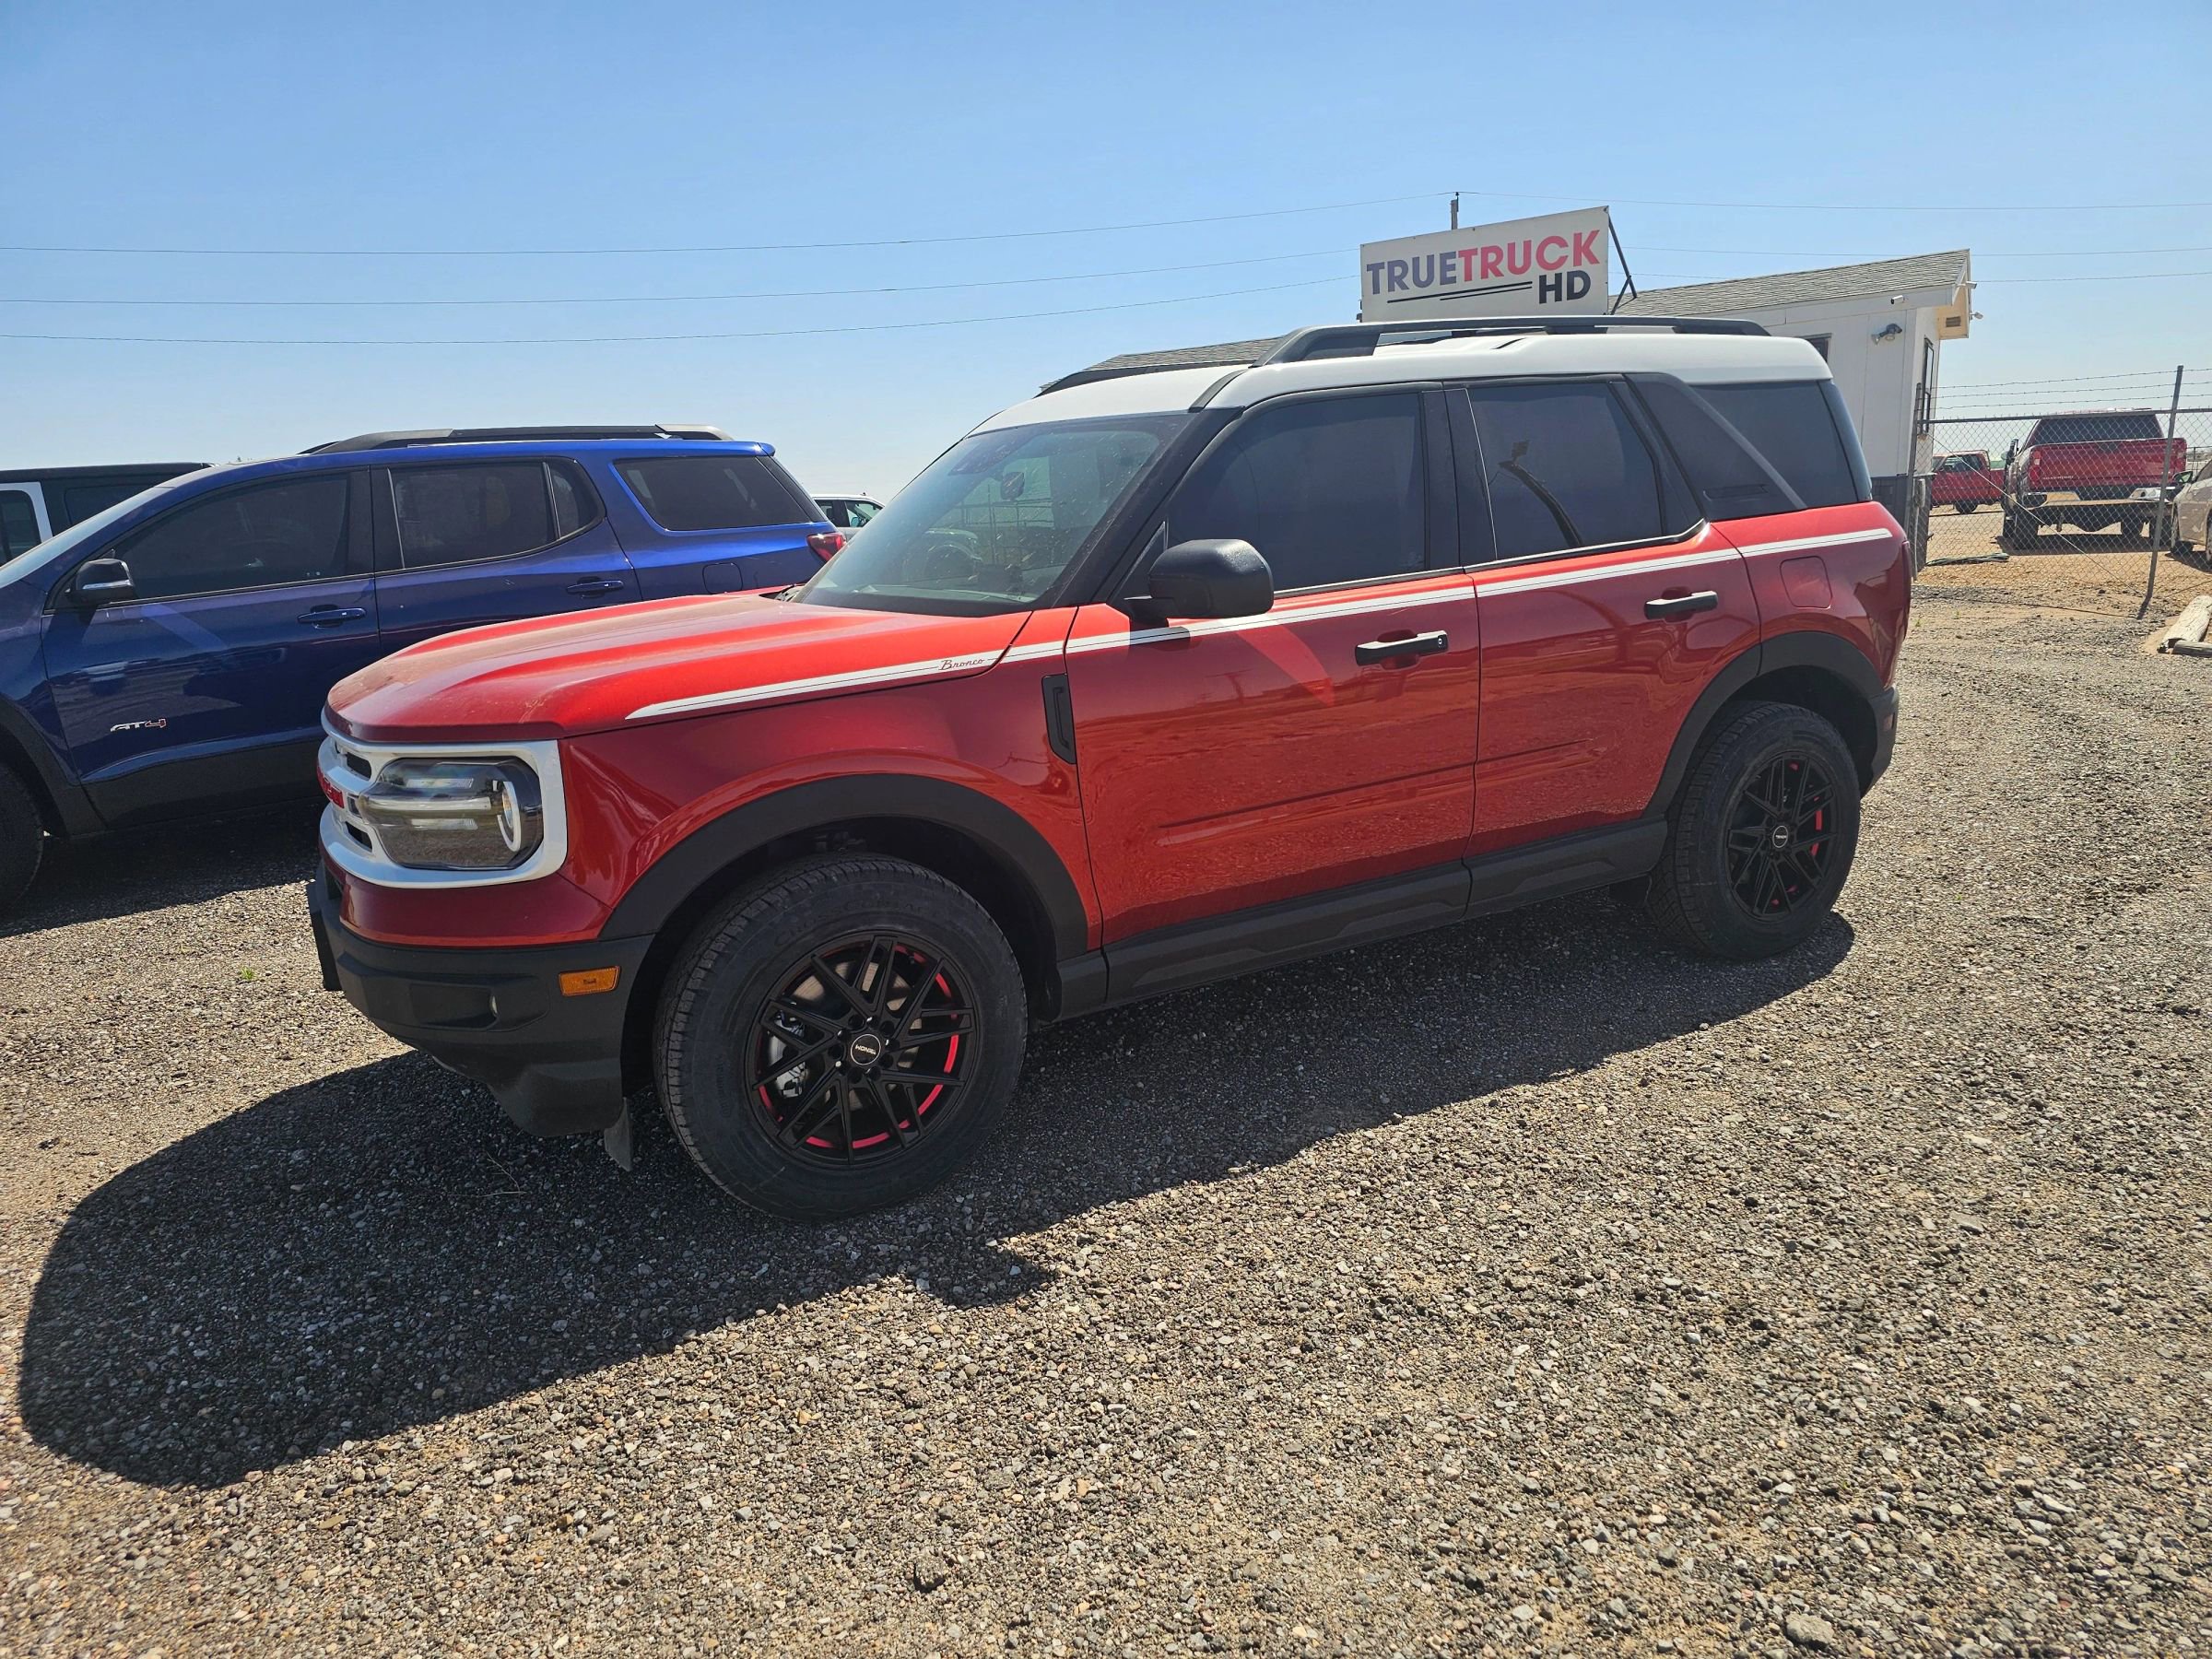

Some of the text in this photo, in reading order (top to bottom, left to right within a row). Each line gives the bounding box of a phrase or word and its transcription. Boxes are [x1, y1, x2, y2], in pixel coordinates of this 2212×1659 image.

[1366, 229, 1600, 295] TRUETRUCK
[1538, 269, 1591, 304] HD
[938, 659, 985, 671] Bronco
[110, 718, 167, 732] AT4
